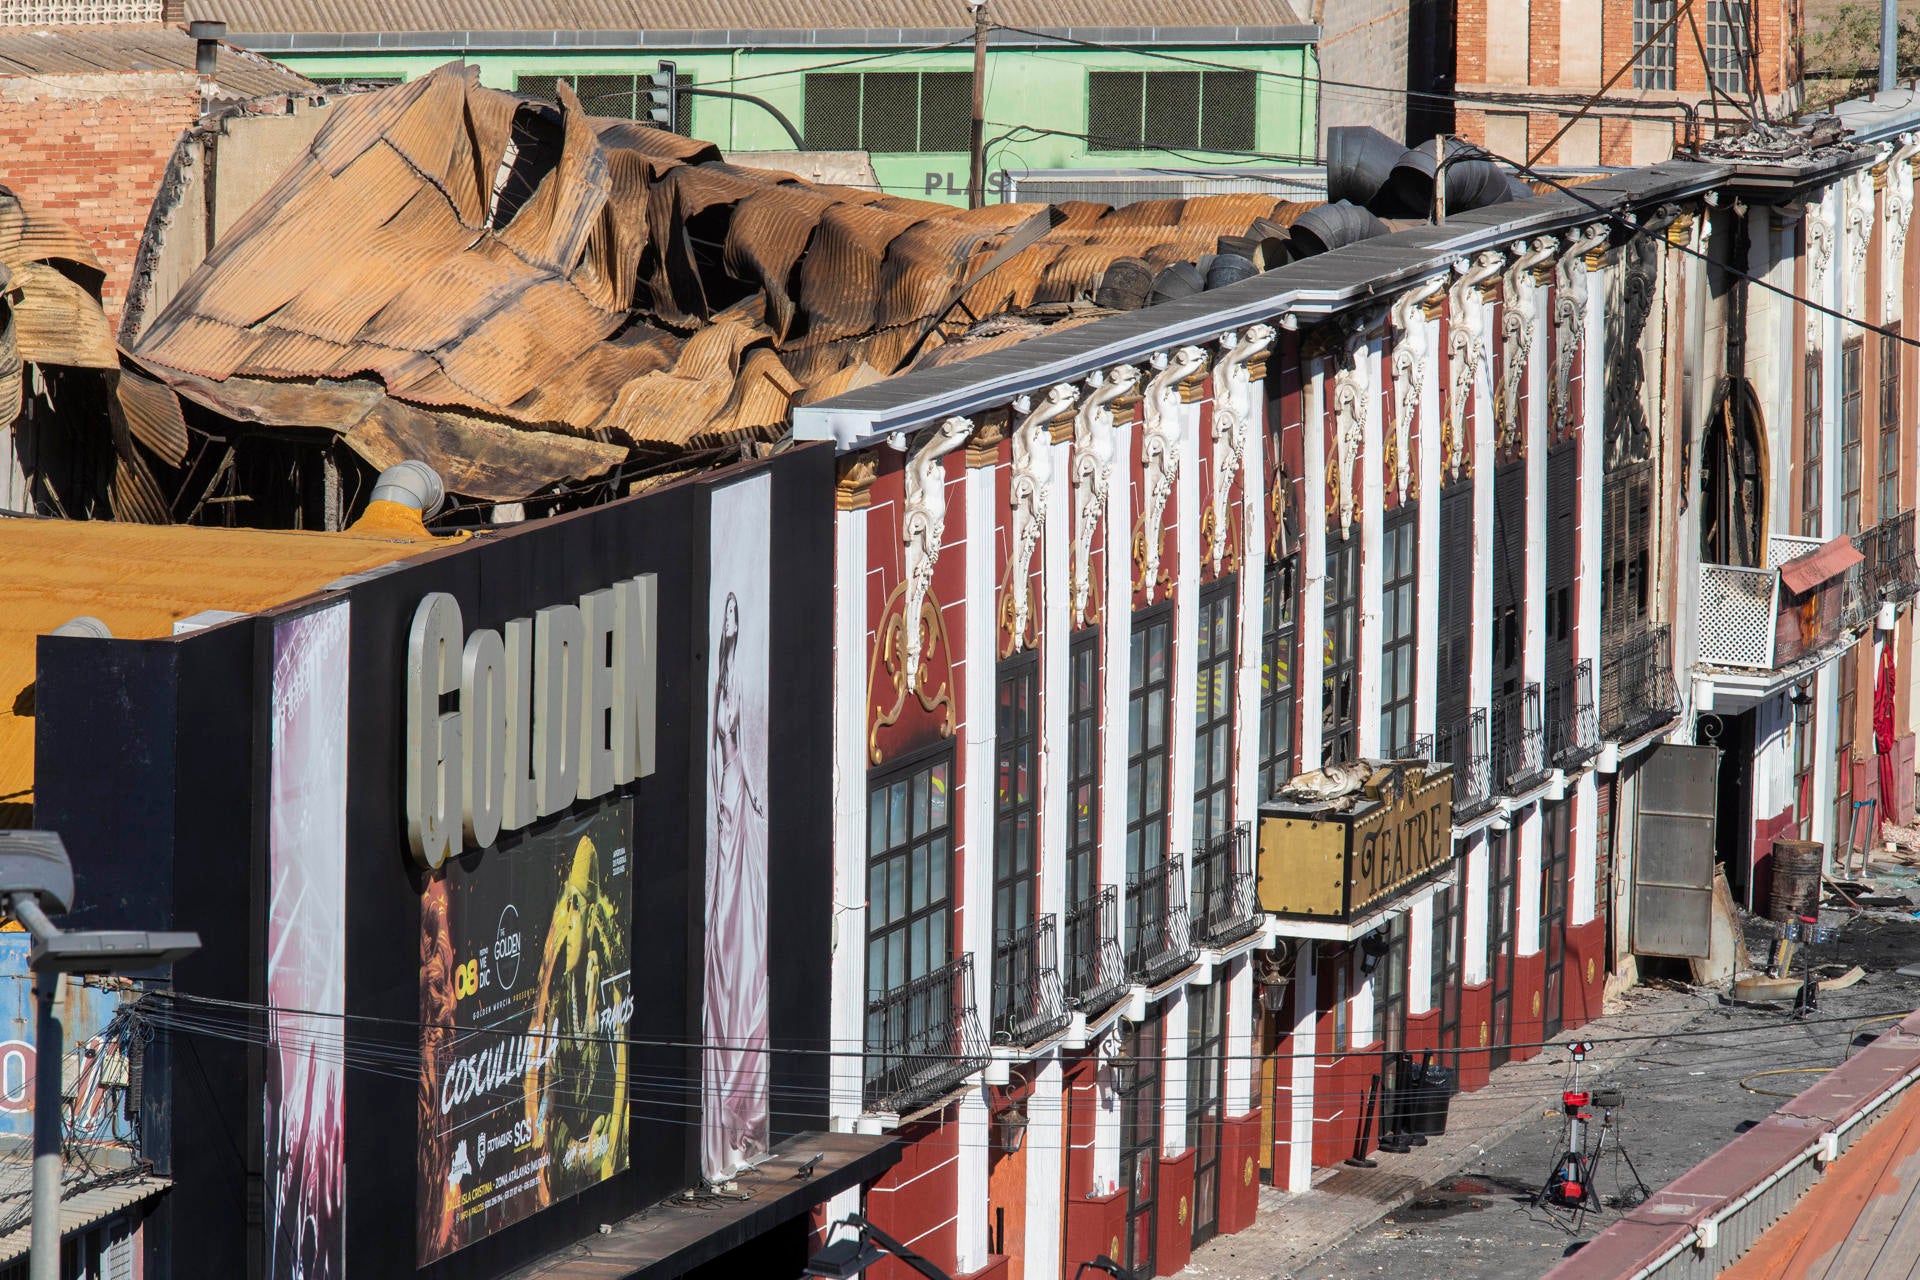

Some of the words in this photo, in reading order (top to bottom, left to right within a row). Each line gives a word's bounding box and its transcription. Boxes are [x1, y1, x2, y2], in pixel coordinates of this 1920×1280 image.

[925, 172, 1002, 196] PLS
[406, 573, 658, 869] GOLDEN
[1361, 803, 1442, 895] TEATRE
[494, 932, 520, 960] GOLDEN
[455, 959, 479, 1000] 08
[480, 969, 490, 989] DIC
[441, 1017, 559, 1115] COSCULLUELA
[514, 1118, 532, 1147] SCS
